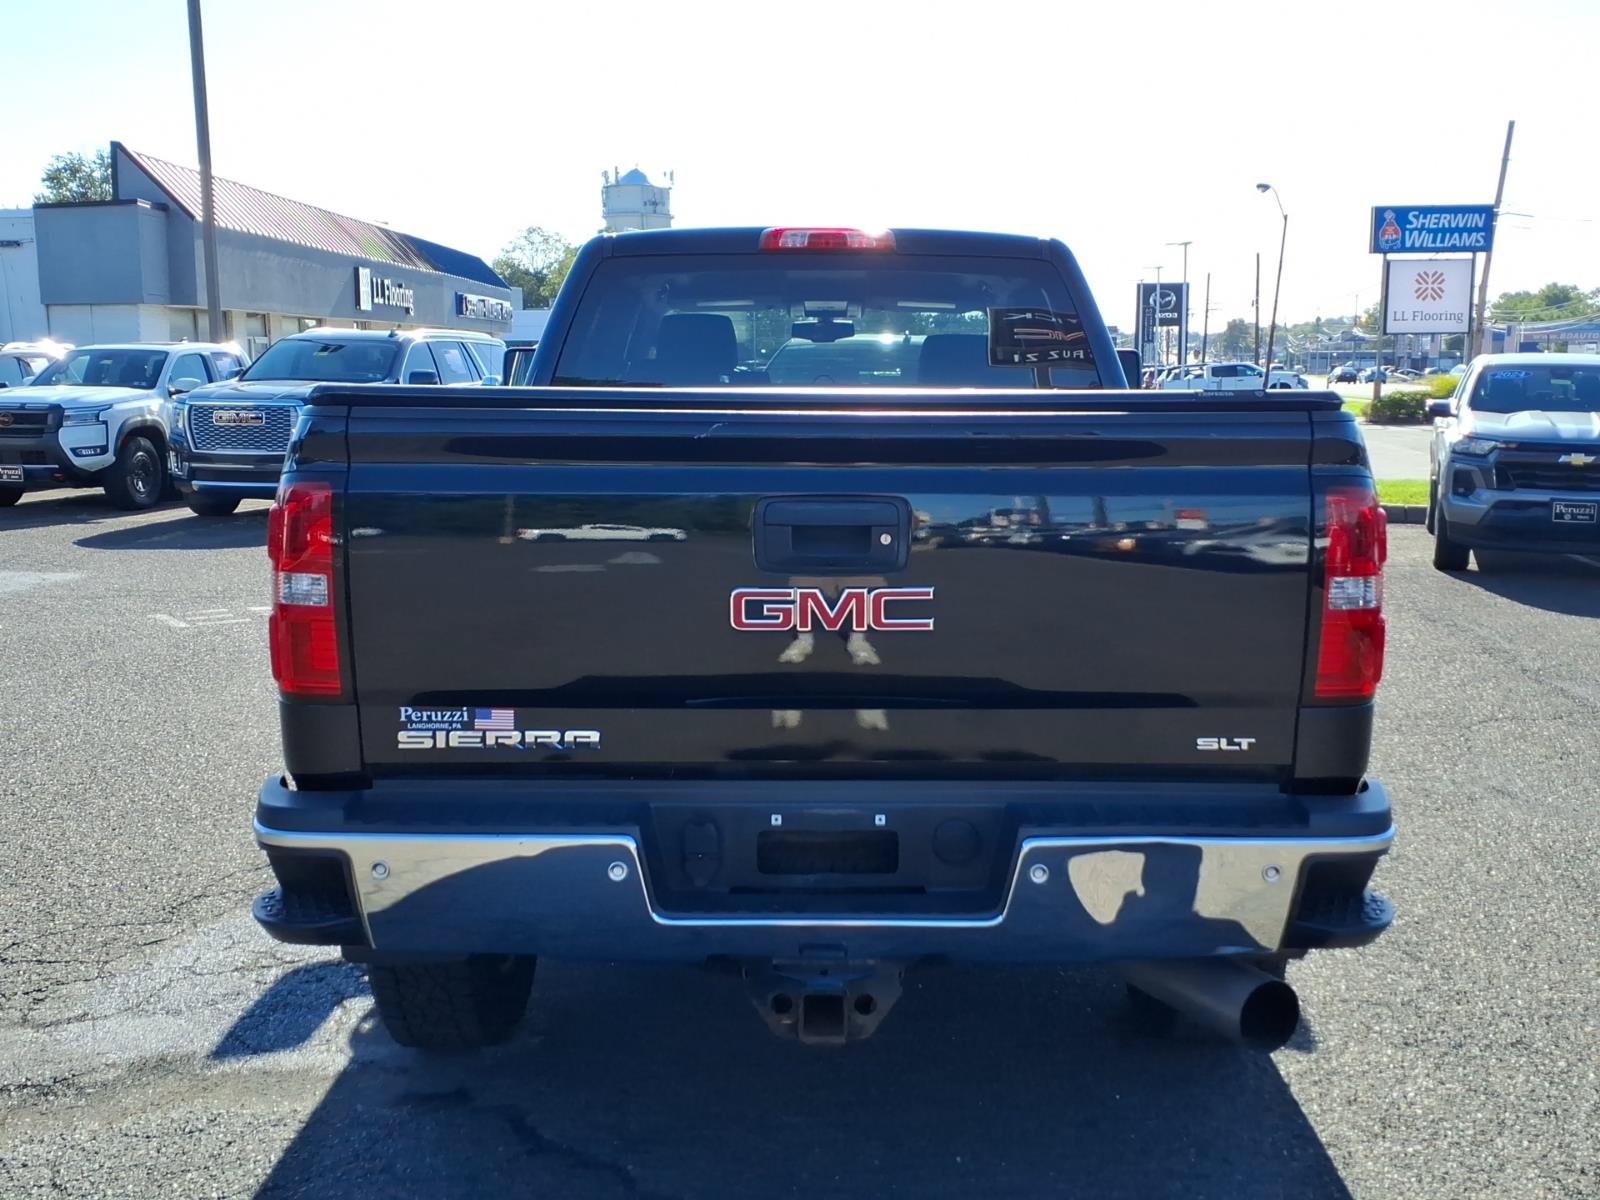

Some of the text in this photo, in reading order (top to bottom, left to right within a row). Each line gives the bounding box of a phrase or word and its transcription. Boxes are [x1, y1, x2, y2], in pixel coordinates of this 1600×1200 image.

[1406, 211, 1486, 229] SHERWIN
[1405, 230, 1485, 248] WILLIAMS
[373, 277, 415, 317] LL Flooring
[1393, 310, 1464, 323] LL Flooring
[215, 413, 262, 423] GMC
[1555, 505, 1594, 514] Peruzzi
[729, 586, 935, 631] GMC
[400, 706, 469, 722] Peruzzi
[397, 730, 601, 750] SIERRA
[1196, 737, 1257, 751] SLT
